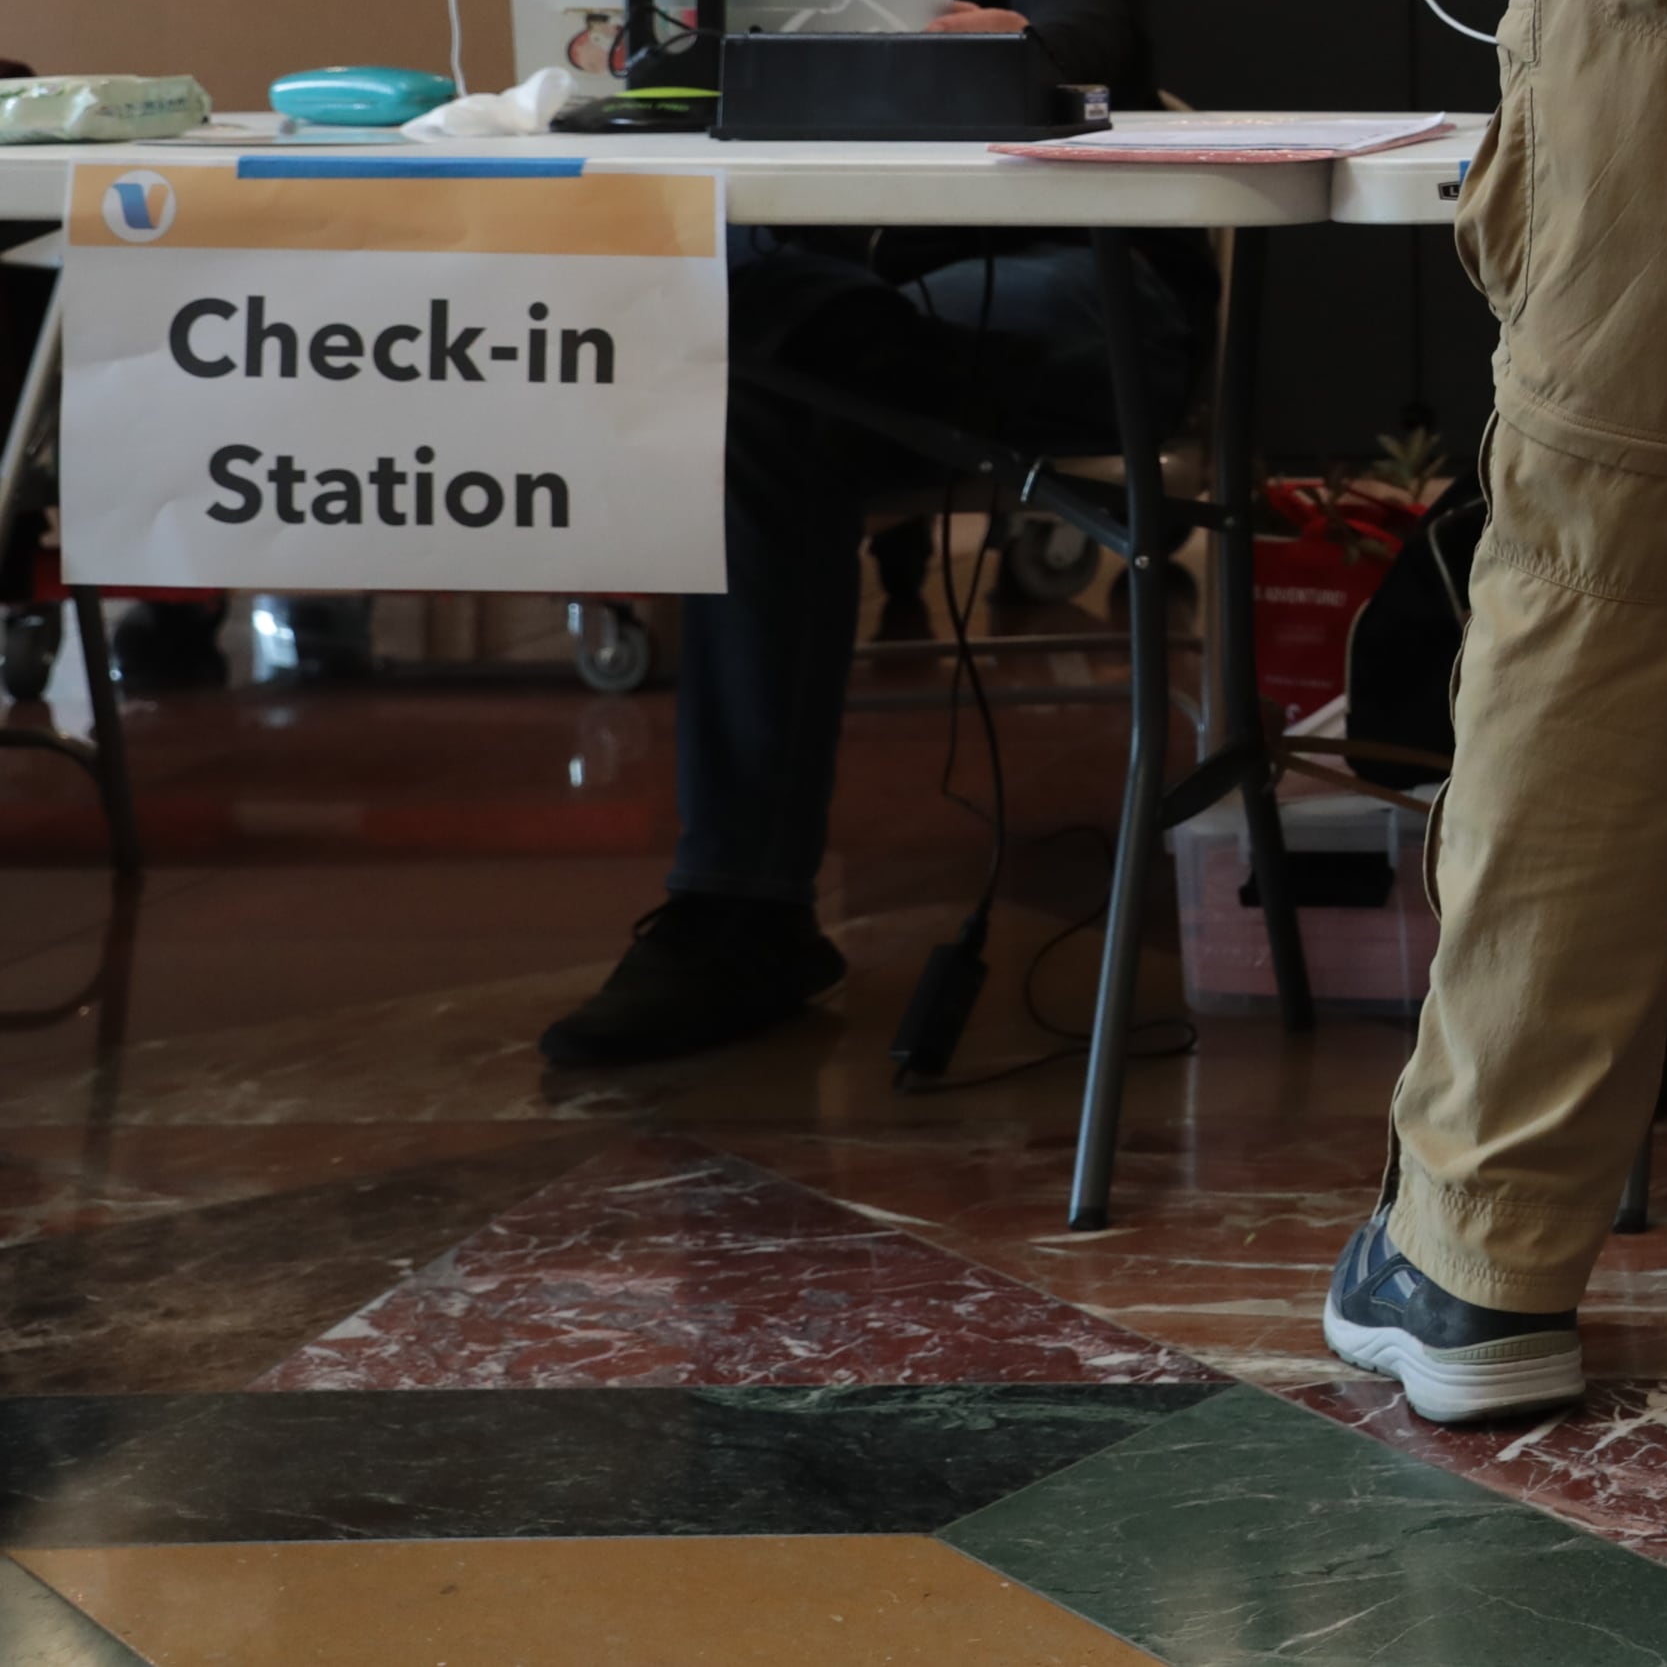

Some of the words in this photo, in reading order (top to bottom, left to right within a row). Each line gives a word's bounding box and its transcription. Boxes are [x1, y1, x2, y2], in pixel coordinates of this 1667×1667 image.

[168, 296, 616, 384] Check-in
[206, 445, 570, 528] Station
[1264, 586, 1348, 608] ADVENTURE!
